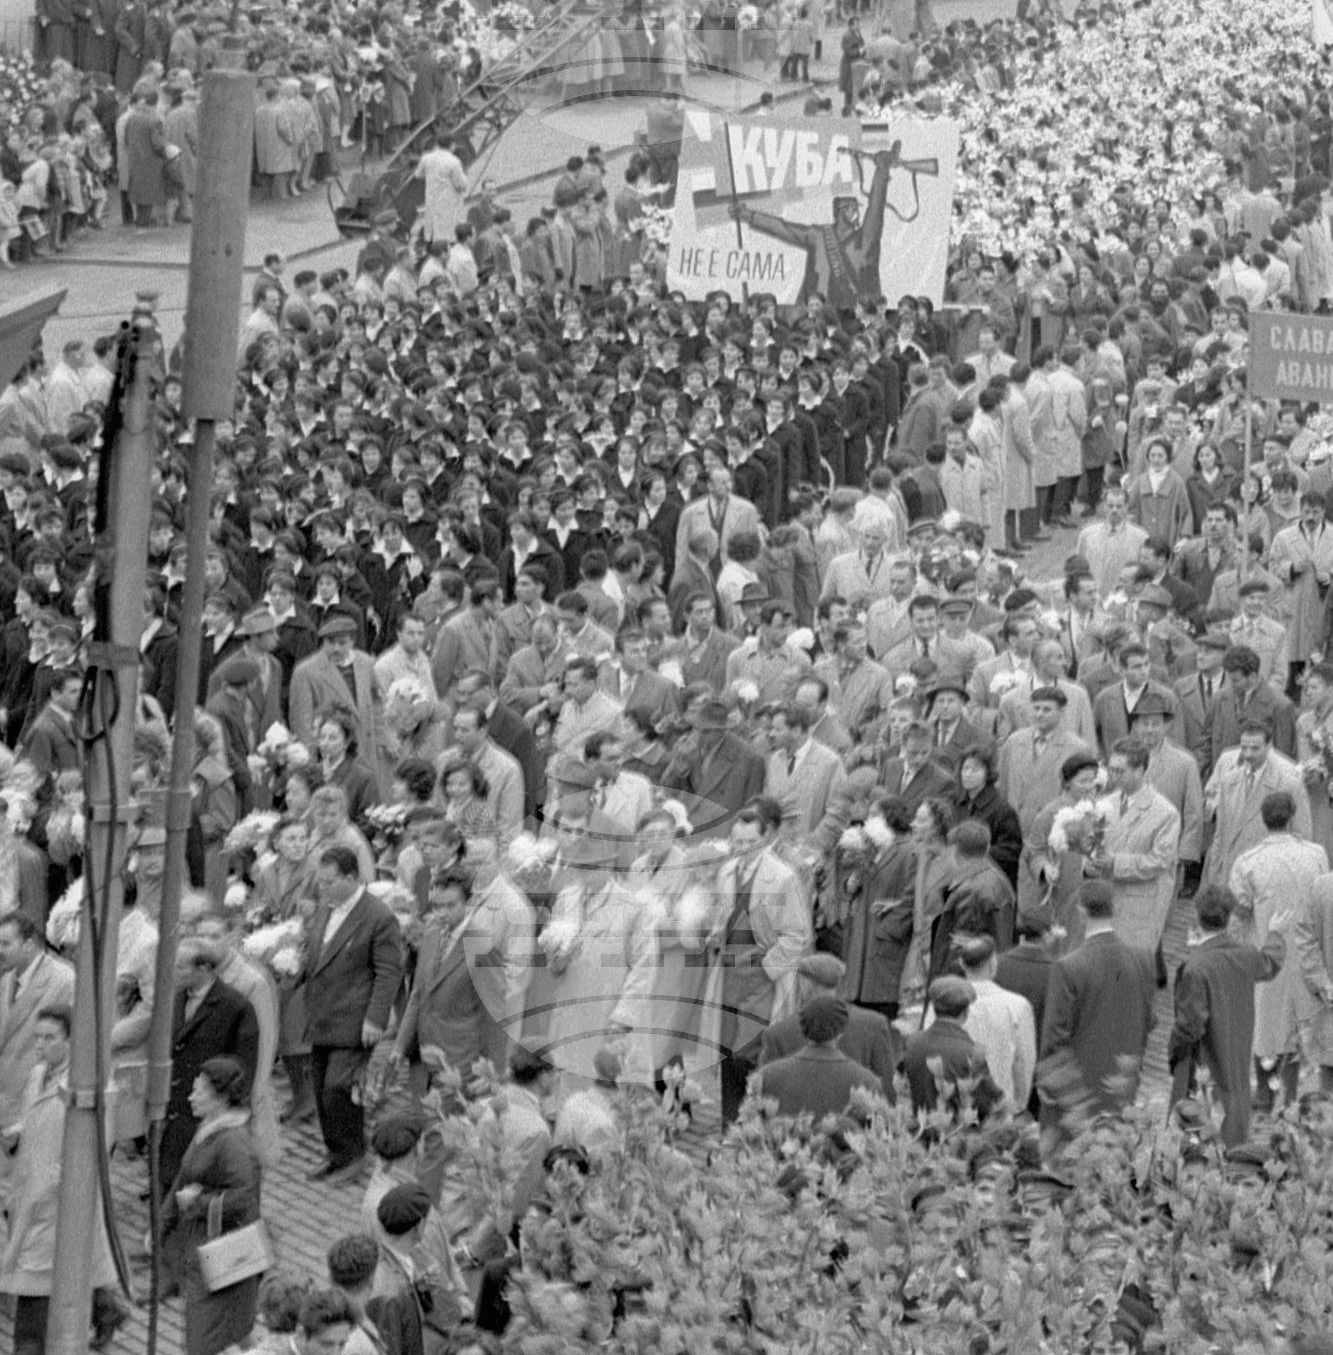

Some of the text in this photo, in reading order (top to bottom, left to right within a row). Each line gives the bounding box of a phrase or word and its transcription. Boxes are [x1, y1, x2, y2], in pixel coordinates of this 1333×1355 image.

[729, 124, 854, 193] КУБА
[679, 247, 704, 277] НЕ
[727, 250, 785, 281] САМА
